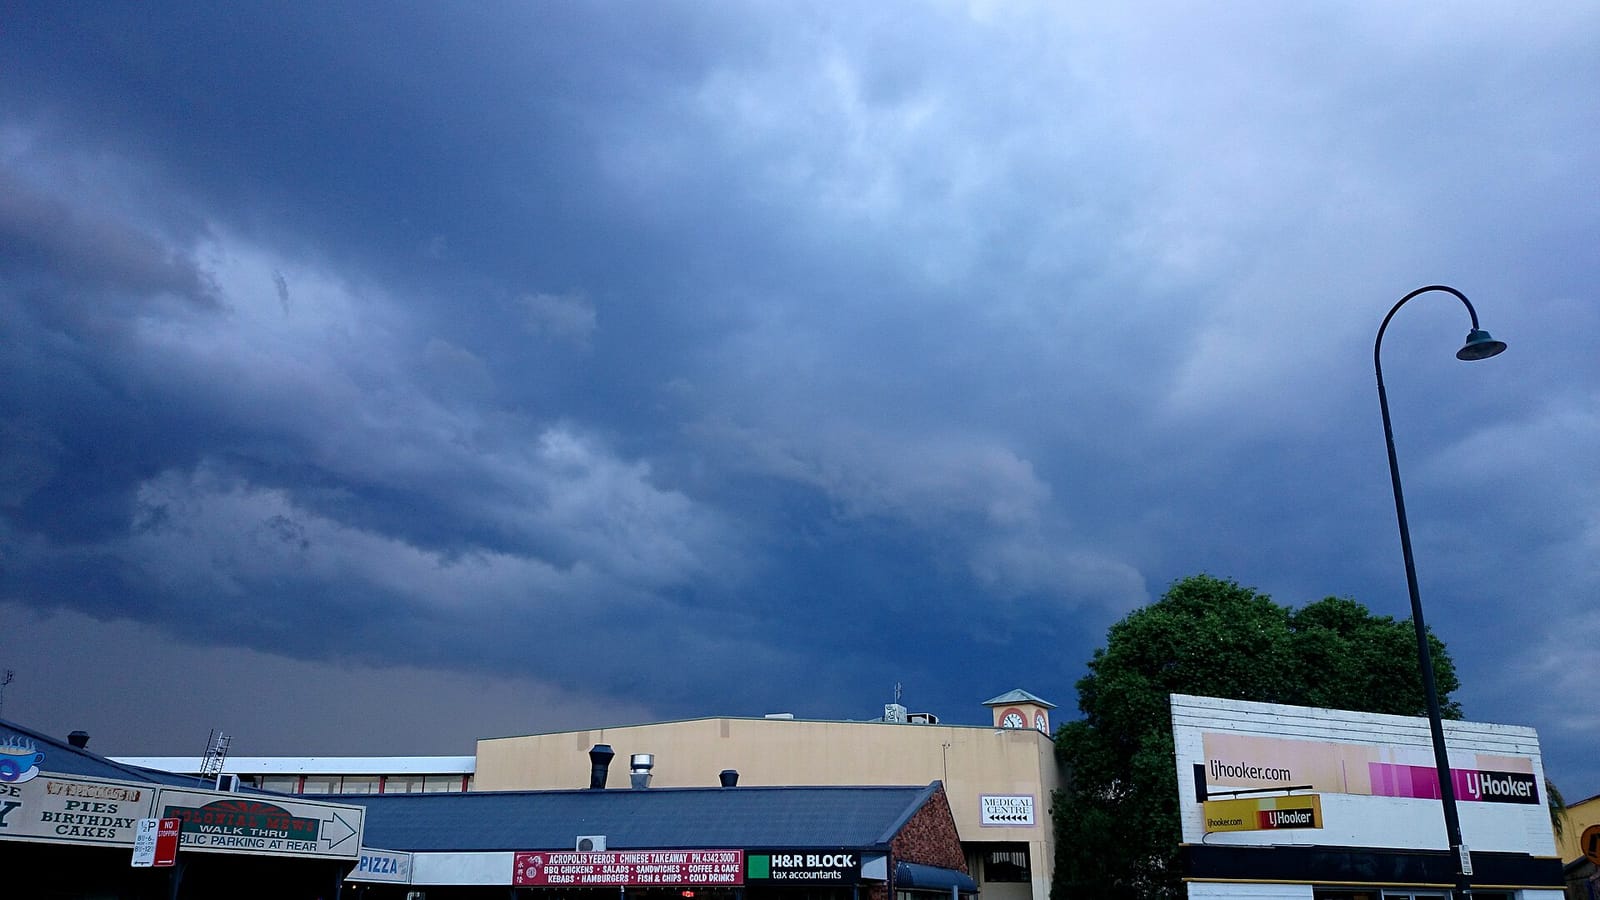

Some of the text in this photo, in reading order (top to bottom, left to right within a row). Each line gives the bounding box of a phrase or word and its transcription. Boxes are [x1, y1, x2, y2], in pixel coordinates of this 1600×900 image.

[1210, 759, 1291, 781] ljhooker.com
[1466, 772, 1533, 799] LJ Hooker
[65, 800, 118, 814] PIES
[984, 798, 1032, 806] MEDICAL
[987, 806, 1030, 814] CENTRE
[41, 811, 135, 829] BIRTHDAY
[164, 820, 174, 829] NO
[170, 808, 314, 832] COLONIAL MEWS
[1269, 810, 1311, 827] LJ Hooker
[55, 825, 116, 838] CAKES
[200, 825, 288, 838] WALK THRU
[211, 836, 265, 848] PARKING
[269, 840, 283, 849] AT
[286, 841, 317, 852] REAR
[359, 855, 397, 874] PIZZA
[549, 854, 587, 864] ACROPOLIS
[589, 854, 616, 864] YEEROS
[620, 854, 649, 864] CHINESE
[650, 853, 688, 863] TAKEAWAY
[771, 854, 803, 867] H&R
[543, 864, 739, 874] BBQ CHICKENS SALADS SANDWICHES COFFEE & CAKE
[773, 870, 842, 879] tax accountants
[547, 873, 735, 883] KEBABS HAMBURGERS FISH & CHIPS COLD DRINKS
